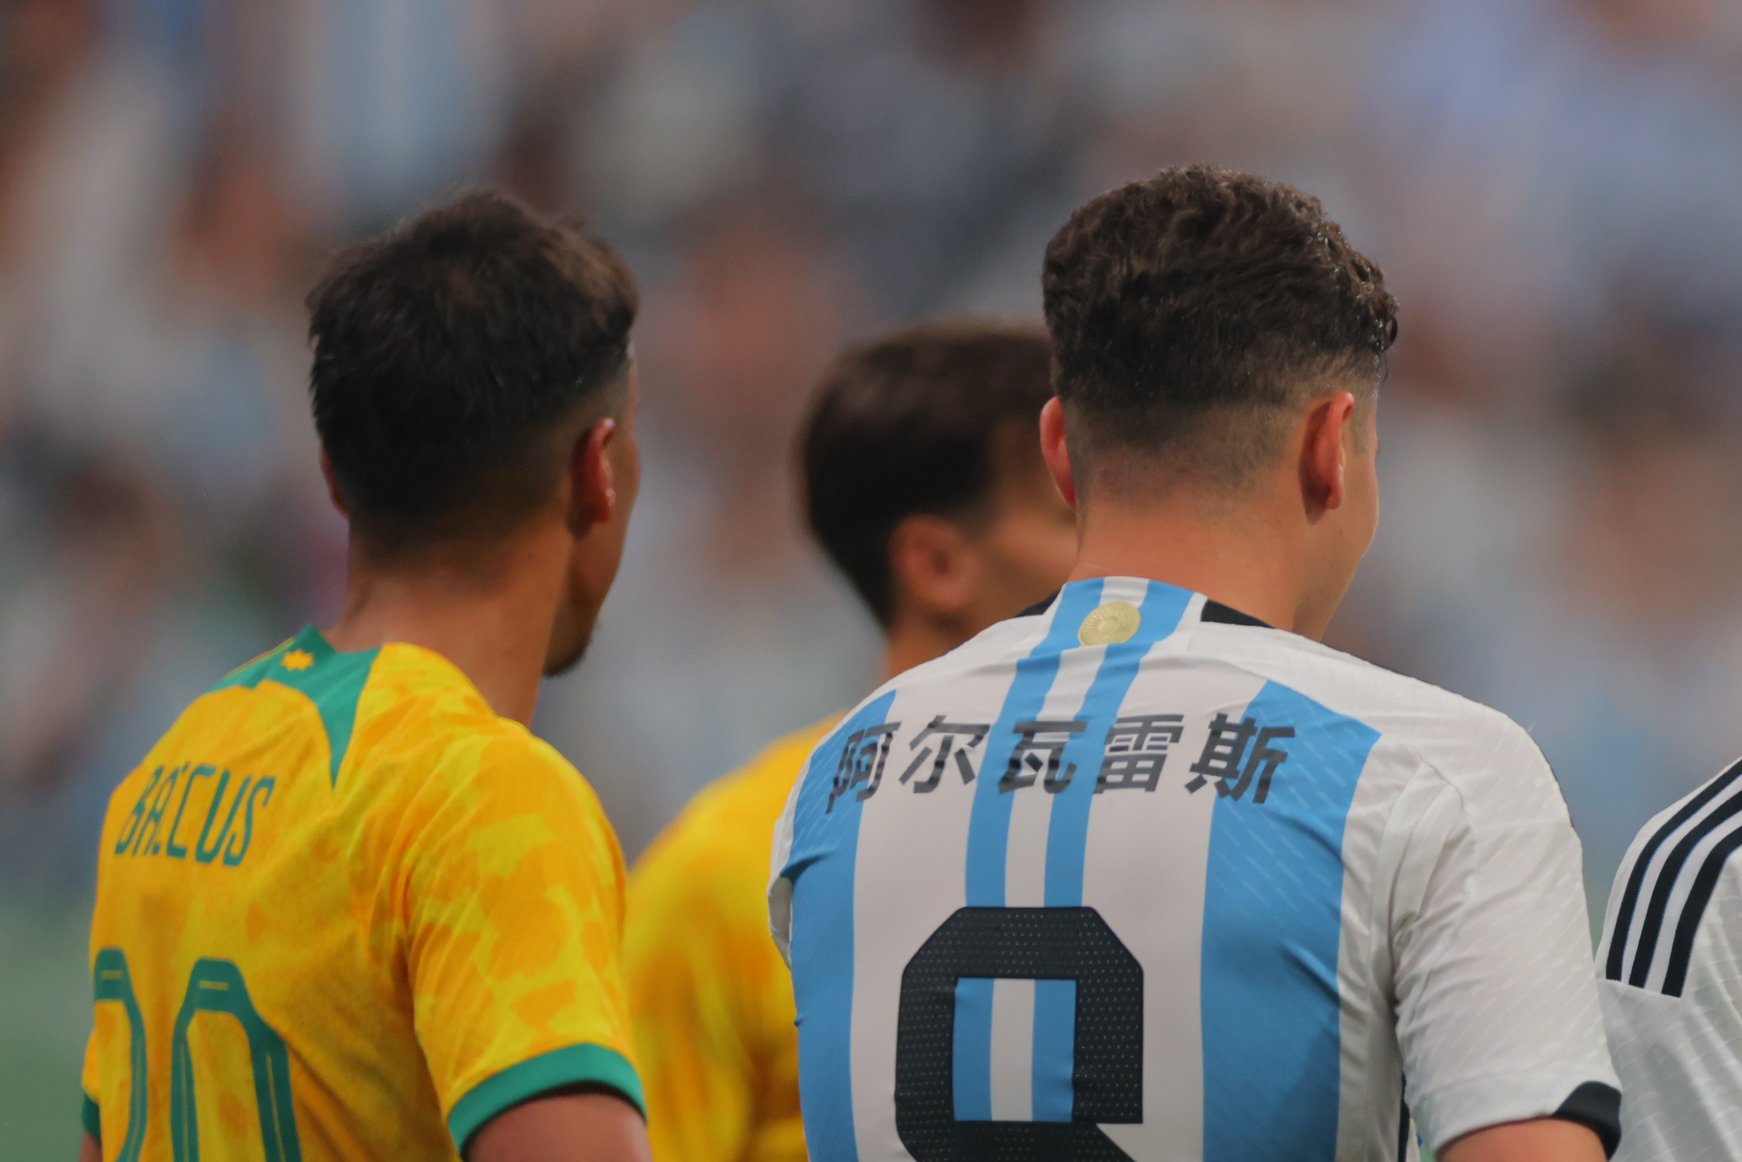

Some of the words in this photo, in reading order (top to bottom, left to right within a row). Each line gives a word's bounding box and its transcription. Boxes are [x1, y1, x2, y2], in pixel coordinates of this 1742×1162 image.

[825, 713, 1296, 814] 阿尔瓦雷斯
